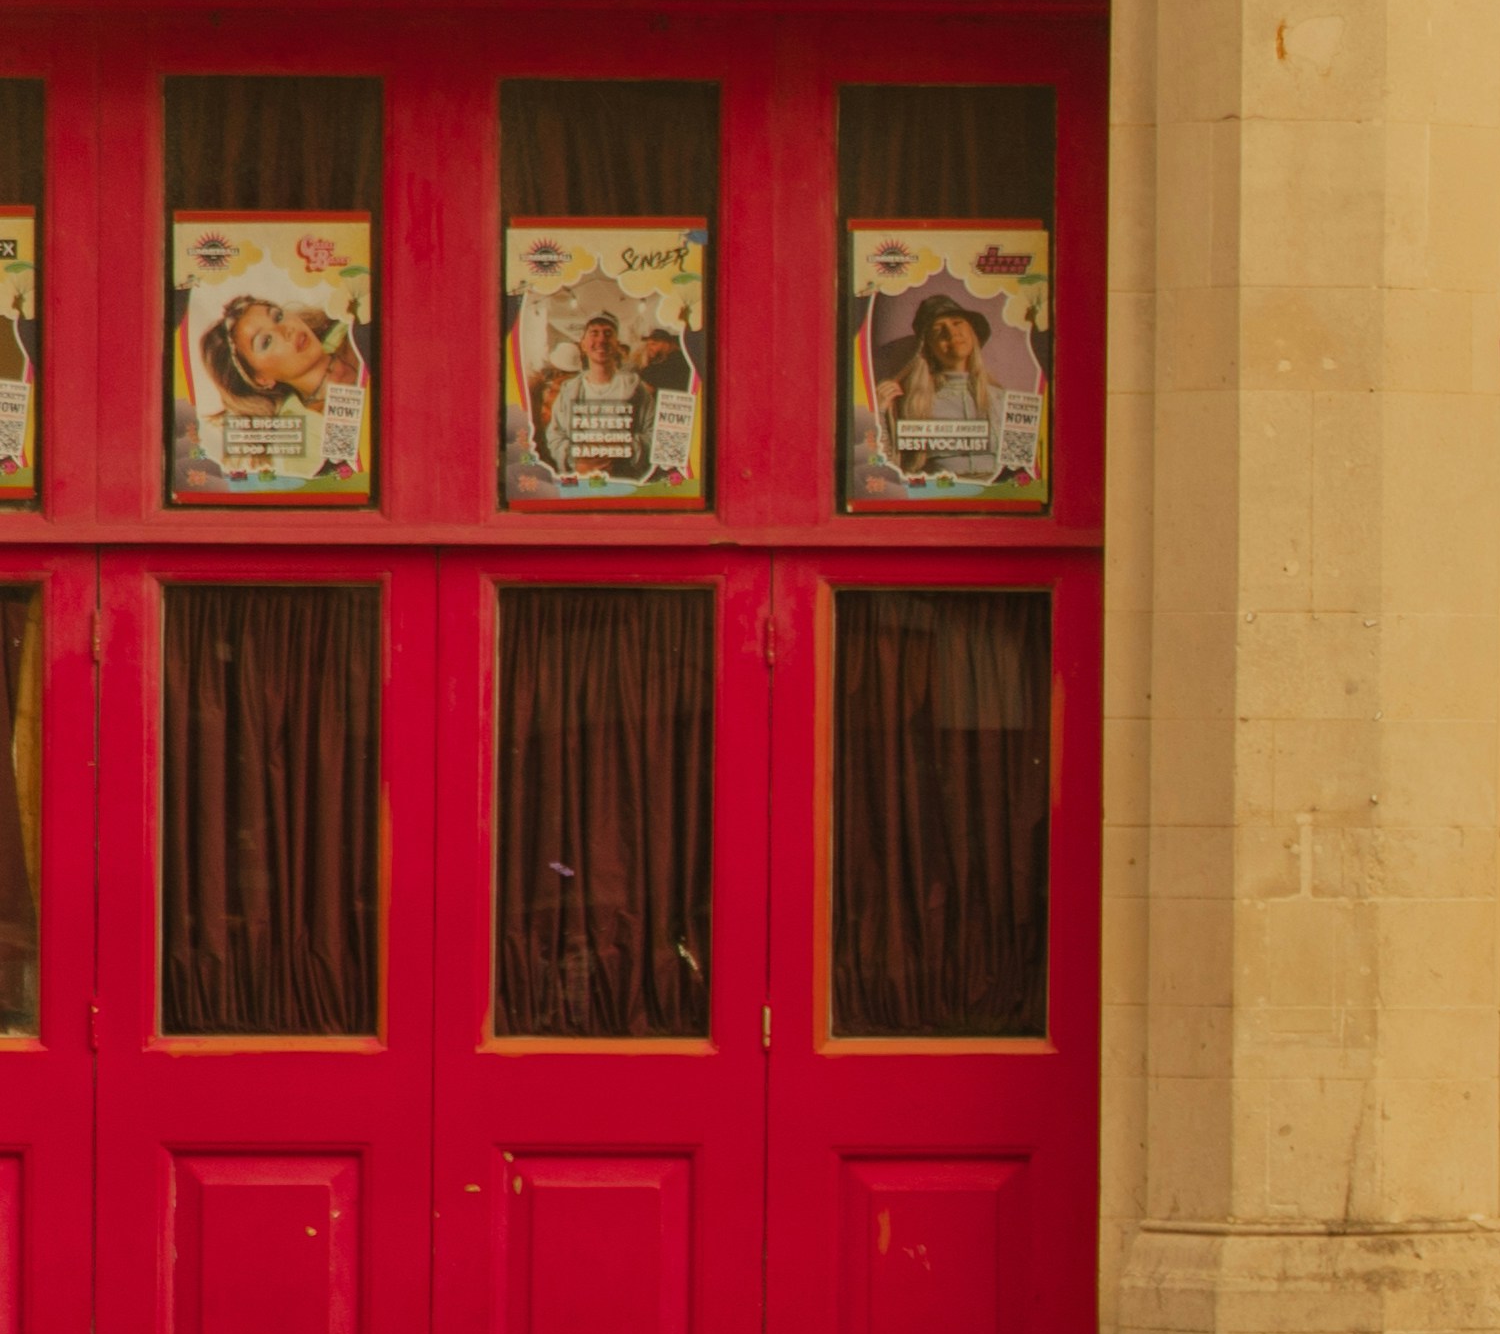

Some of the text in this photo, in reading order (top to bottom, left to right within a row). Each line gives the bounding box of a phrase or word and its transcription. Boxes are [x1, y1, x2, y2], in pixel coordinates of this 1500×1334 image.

[328, 405, 360, 417] NOW!
[229, 419, 302, 429] THE BIGGEST
[572, 417, 633, 429] FASTEST
[659, 412, 691, 424] NOW!
[1006, 412, 1038, 425] NOW!
[901, 425, 924, 434] DRUM
[934, 425, 953, 434] BASS
[955, 425, 986, 434] AWARDS
[571, 433, 633, 443] EMERGING
[227, 445, 301, 455] UK POP ARTIST
[898, 439, 989, 451] BEST VOCALIST
[571, 446, 633, 458] RAPPERS
